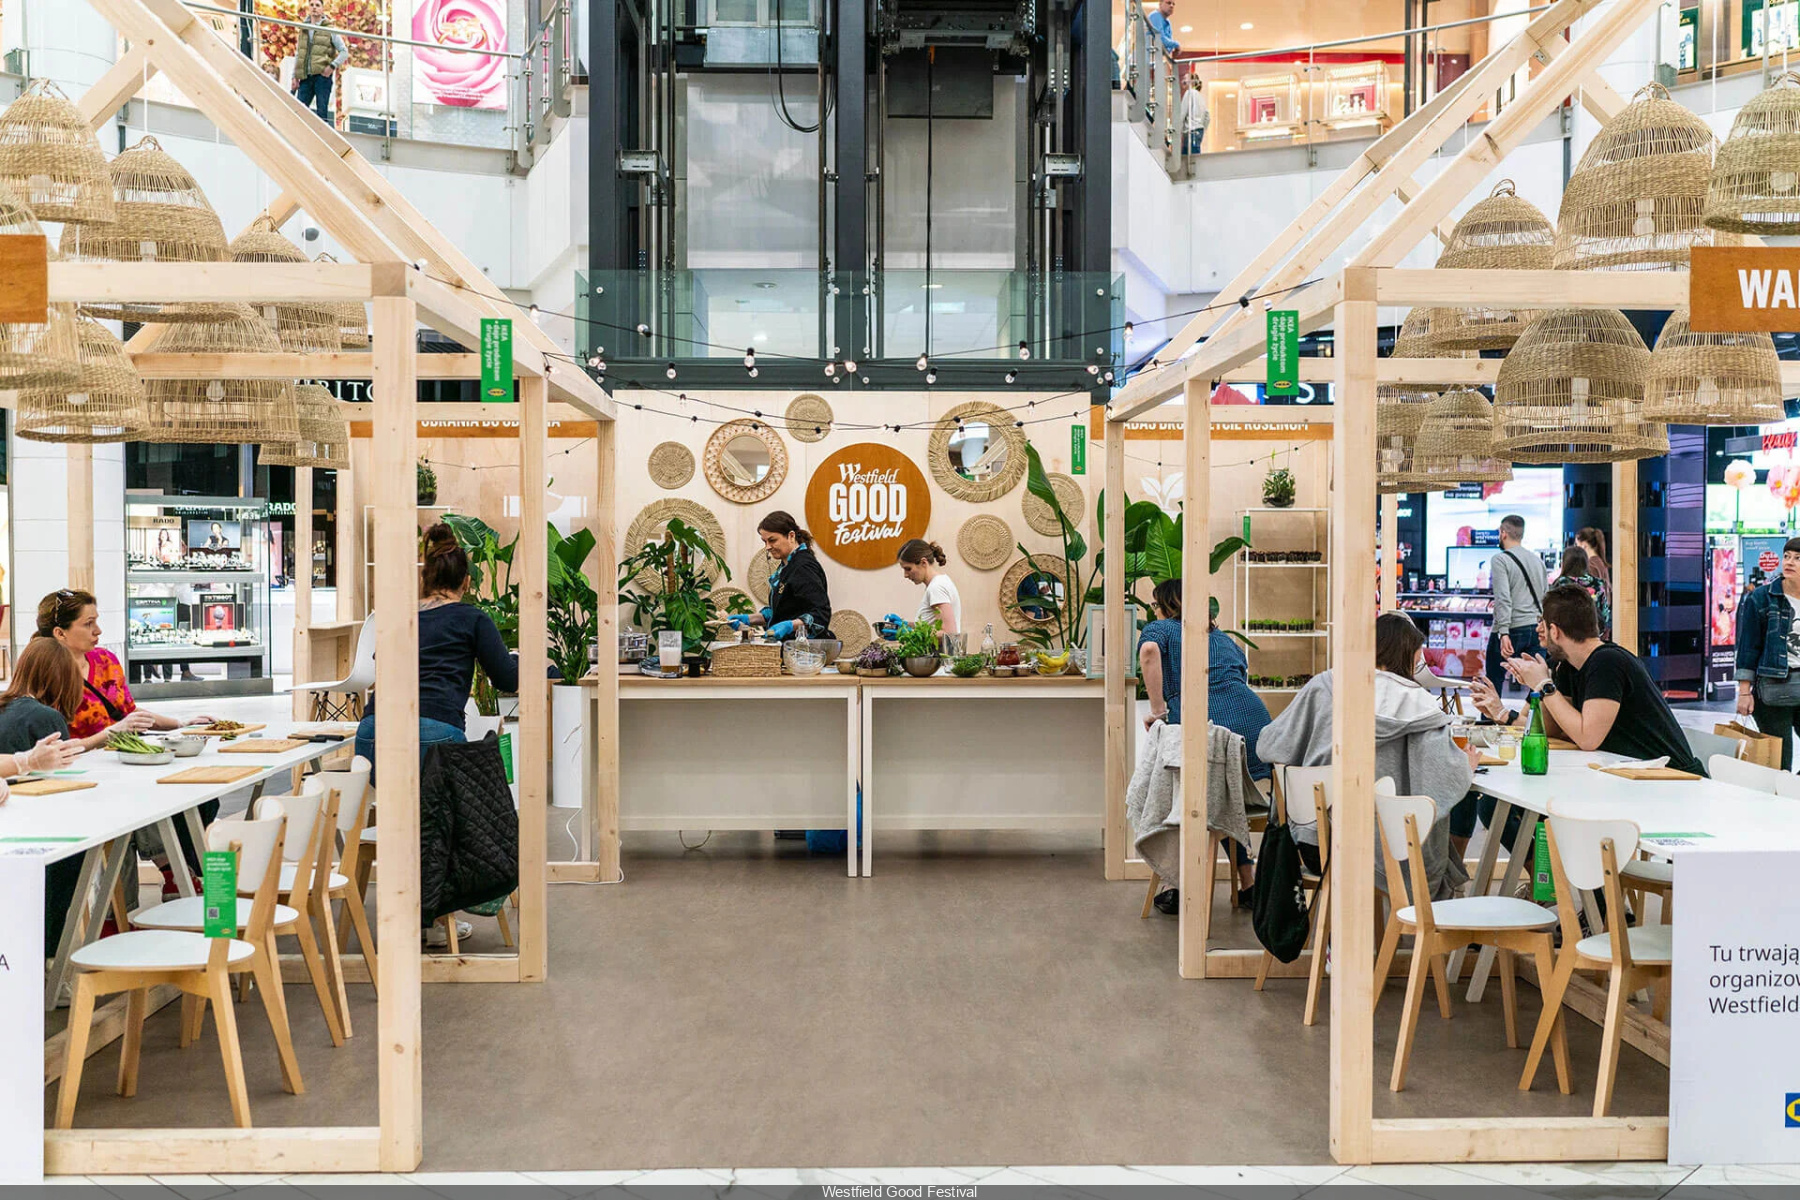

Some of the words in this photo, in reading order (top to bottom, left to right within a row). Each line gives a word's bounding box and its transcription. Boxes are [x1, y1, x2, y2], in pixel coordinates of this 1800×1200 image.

[1737, 269, 1800, 309] WA
[492, 324, 501, 339] daje
[1271, 316, 1279, 341] drugie
[1279, 316, 1287, 331] daje
[484, 324, 492, 349] drugie
[492, 340, 501, 381] produktom
[1279, 332, 1287, 373] produktom
[837, 462, 900, 484] Westfield
[828, 482, 907, 523] GOOD
[834, 520, 903, 546] Festival
[1709, 945, 1732, 962] Tu
[1739, 944, 1799, 966] trwają
[1708, 995, 1799, 1014] Westfield
